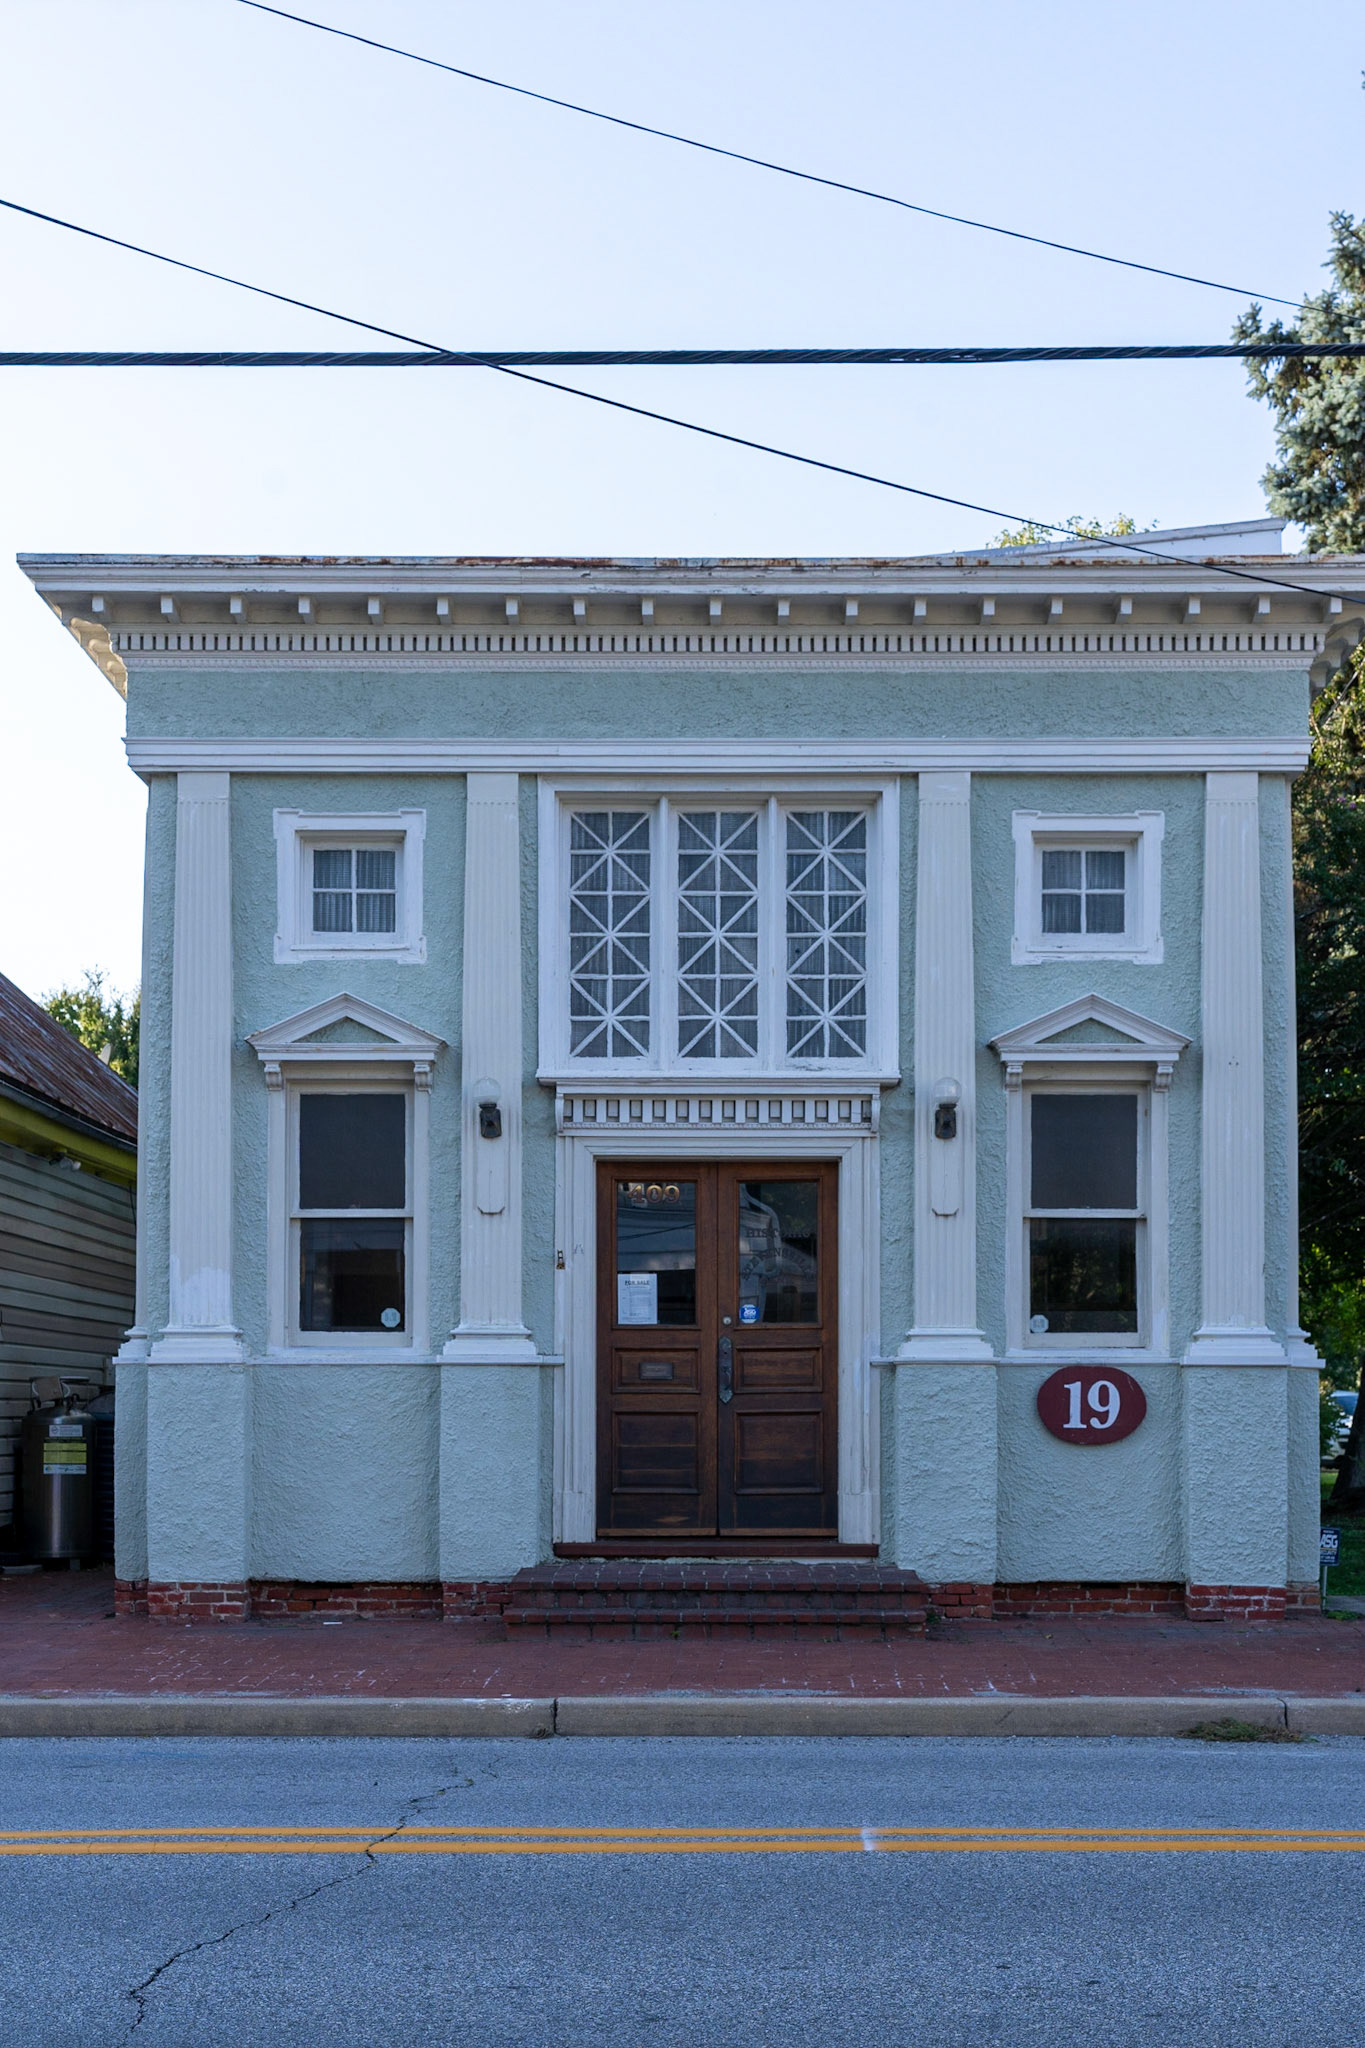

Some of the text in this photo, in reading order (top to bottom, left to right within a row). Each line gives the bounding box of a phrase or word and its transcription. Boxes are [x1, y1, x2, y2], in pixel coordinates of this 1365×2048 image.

[628, 1184, 681, 1203] 409
[1063, 1380, 1120, 1429] 19
[1320, 1534, 1339, 1549] ASG
